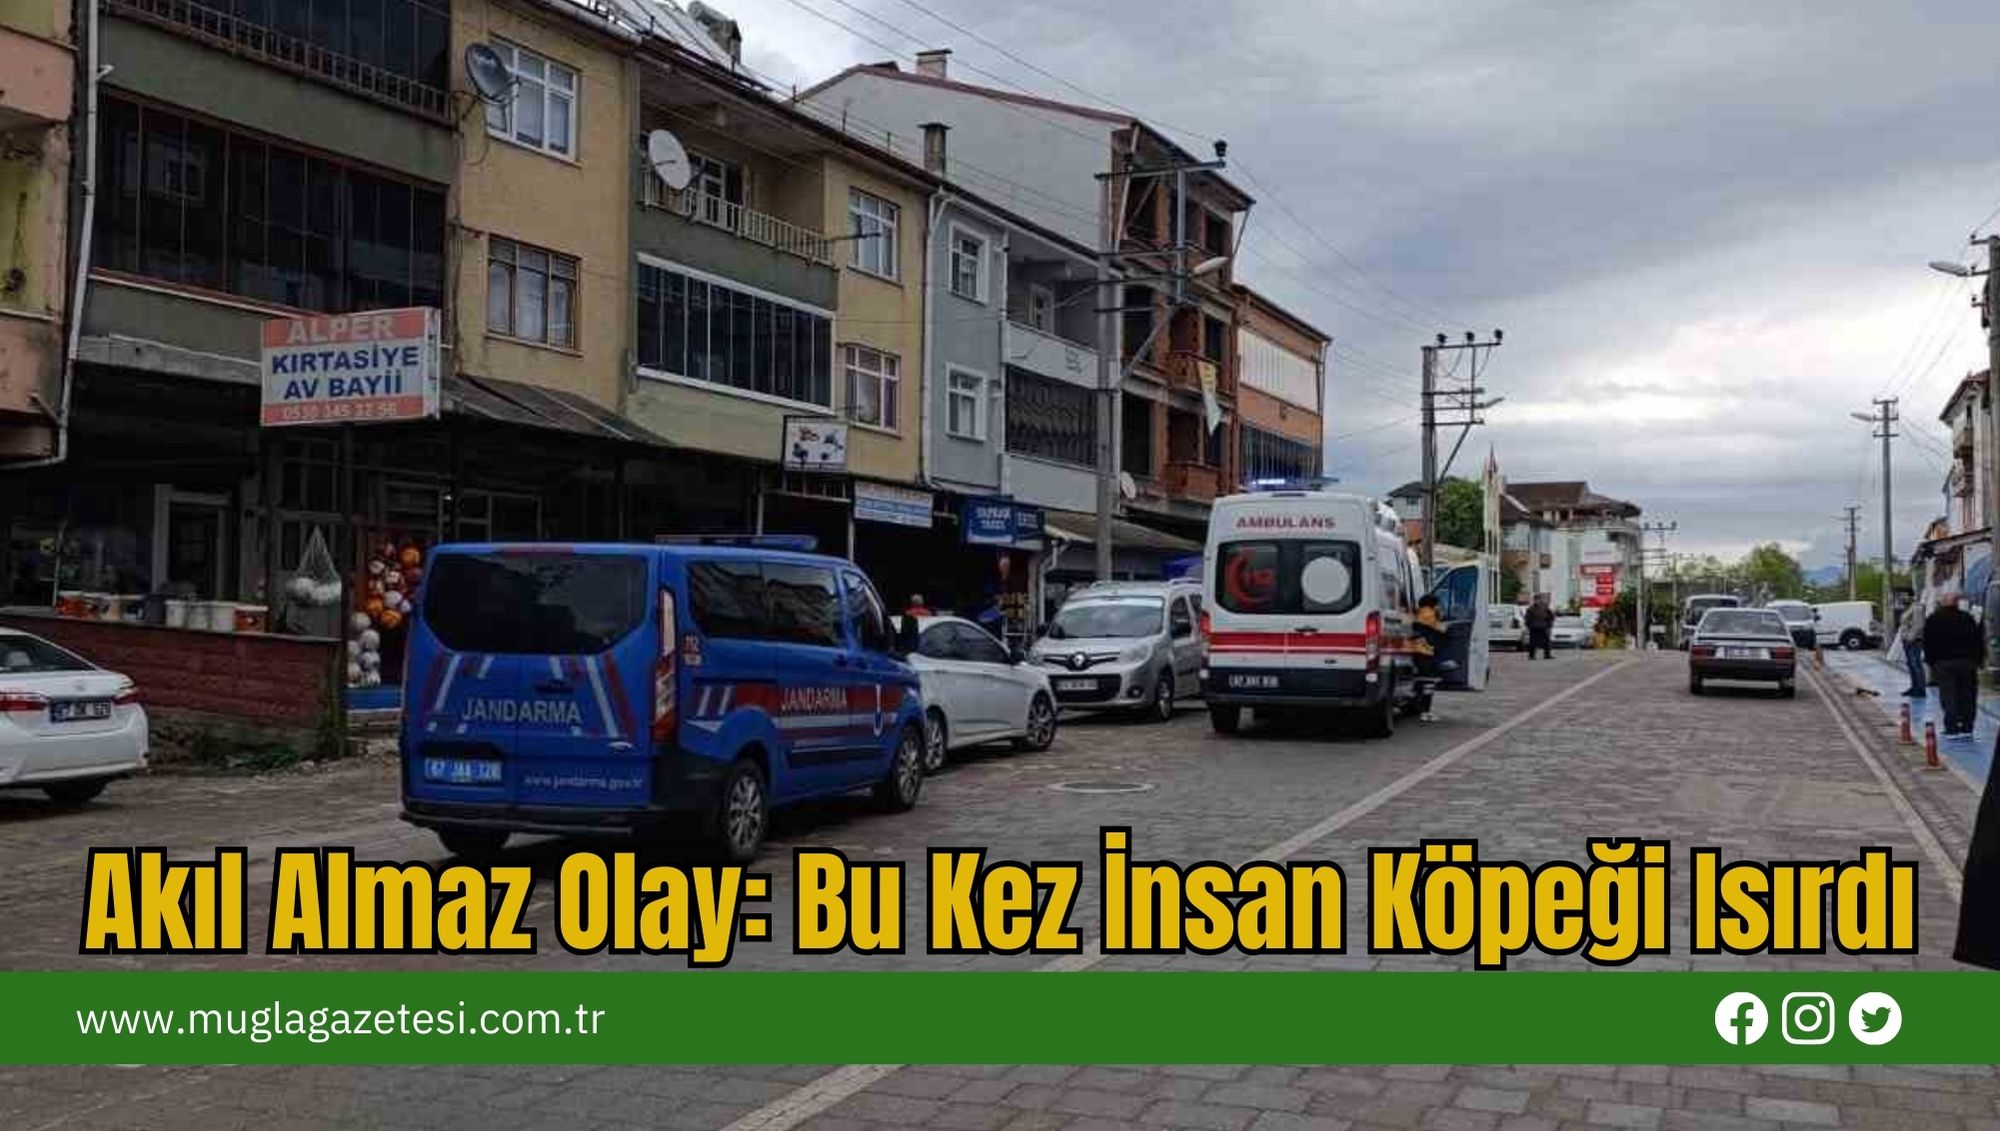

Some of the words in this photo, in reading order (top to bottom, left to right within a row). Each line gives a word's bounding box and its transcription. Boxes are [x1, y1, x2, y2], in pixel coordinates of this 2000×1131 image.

[287, 315, 393, 343] ALPER
[272, 344, 419, 374] KIRTASİYE
[284, 378, 319, 399] AV
[1236, 515, 1336, 528] AMBULANS
[462, 698, 582, 724] JANDARMA
[781, 686, 847, 713] JANDARMA
